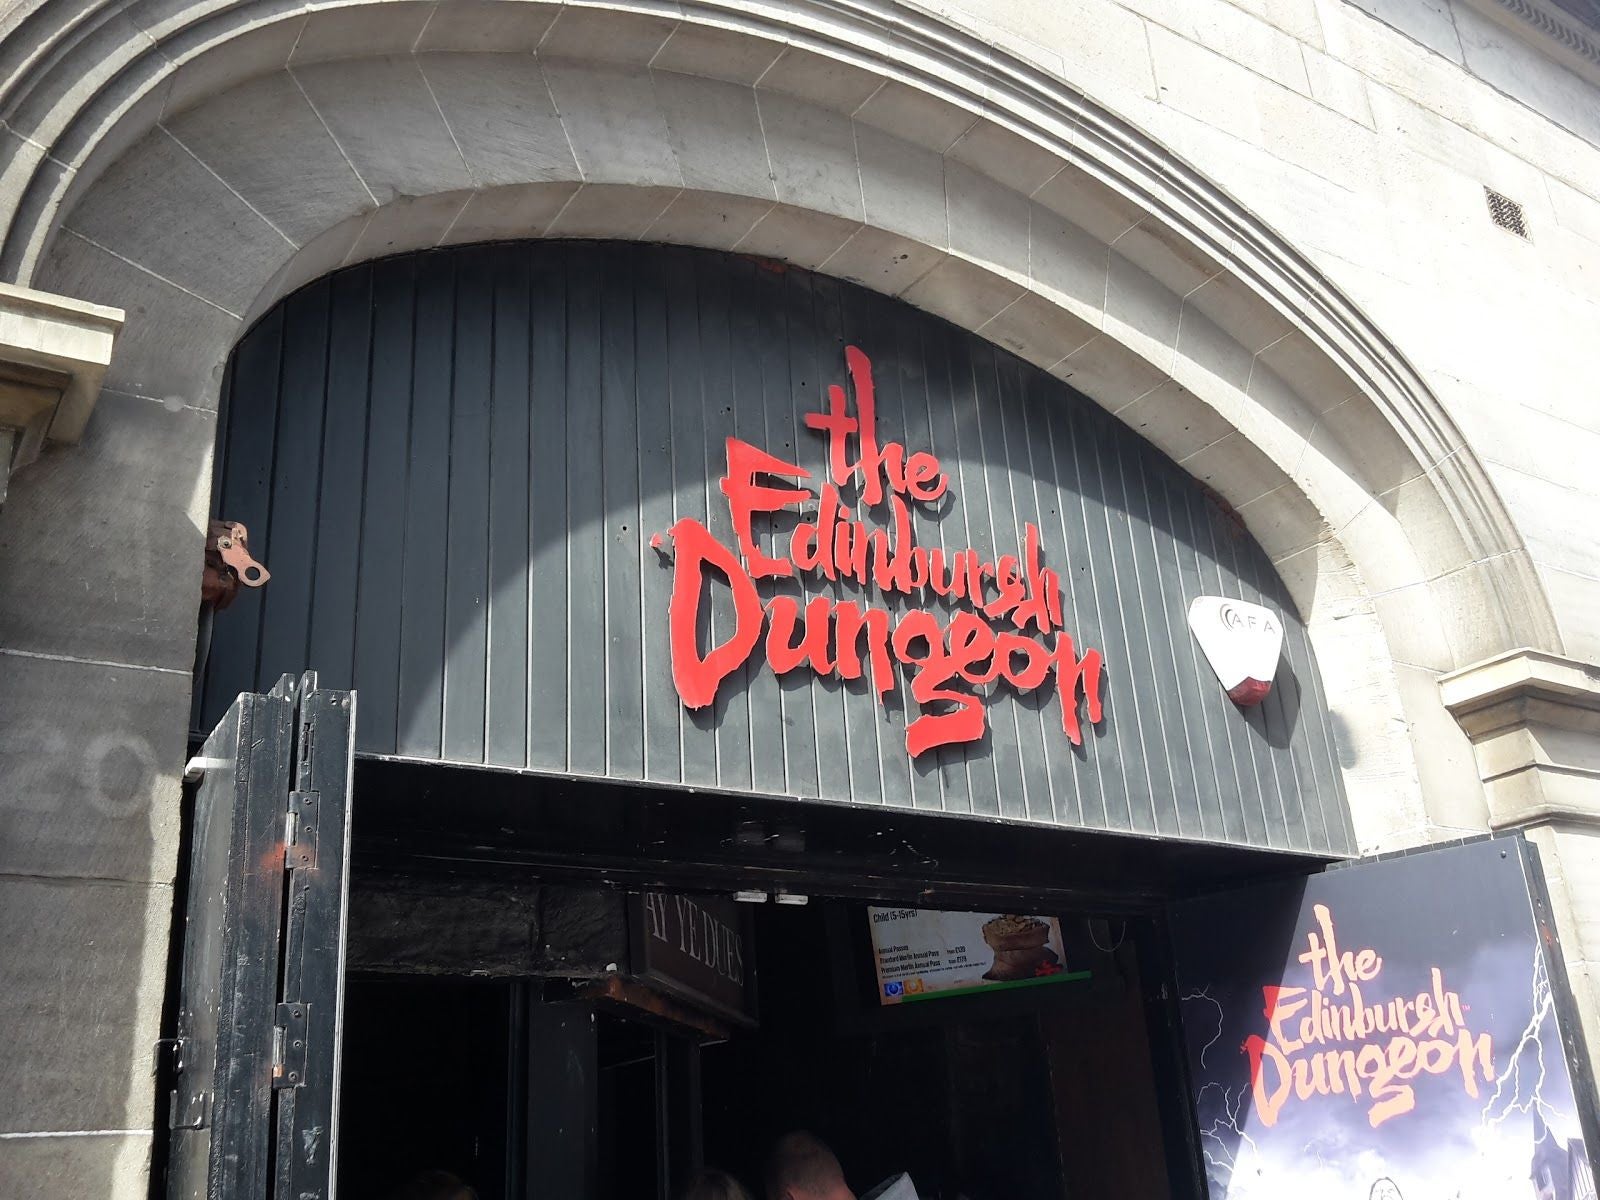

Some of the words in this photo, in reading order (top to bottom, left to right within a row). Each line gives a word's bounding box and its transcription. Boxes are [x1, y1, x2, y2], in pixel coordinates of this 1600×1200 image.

[804, 345, 948, 506] the
[719, 436, 1064, 635] Edinburgh
[650, 517, 1102, 758] Dungeon
[701, 909, 744, 987] DUES
[873, 911, 889, 923] Child
[1299, 904, 1382, 995] the
[1262, 967, 1464, 1055] Edinburgh
[1240, 1029, 1495, 1128] Dungeon
